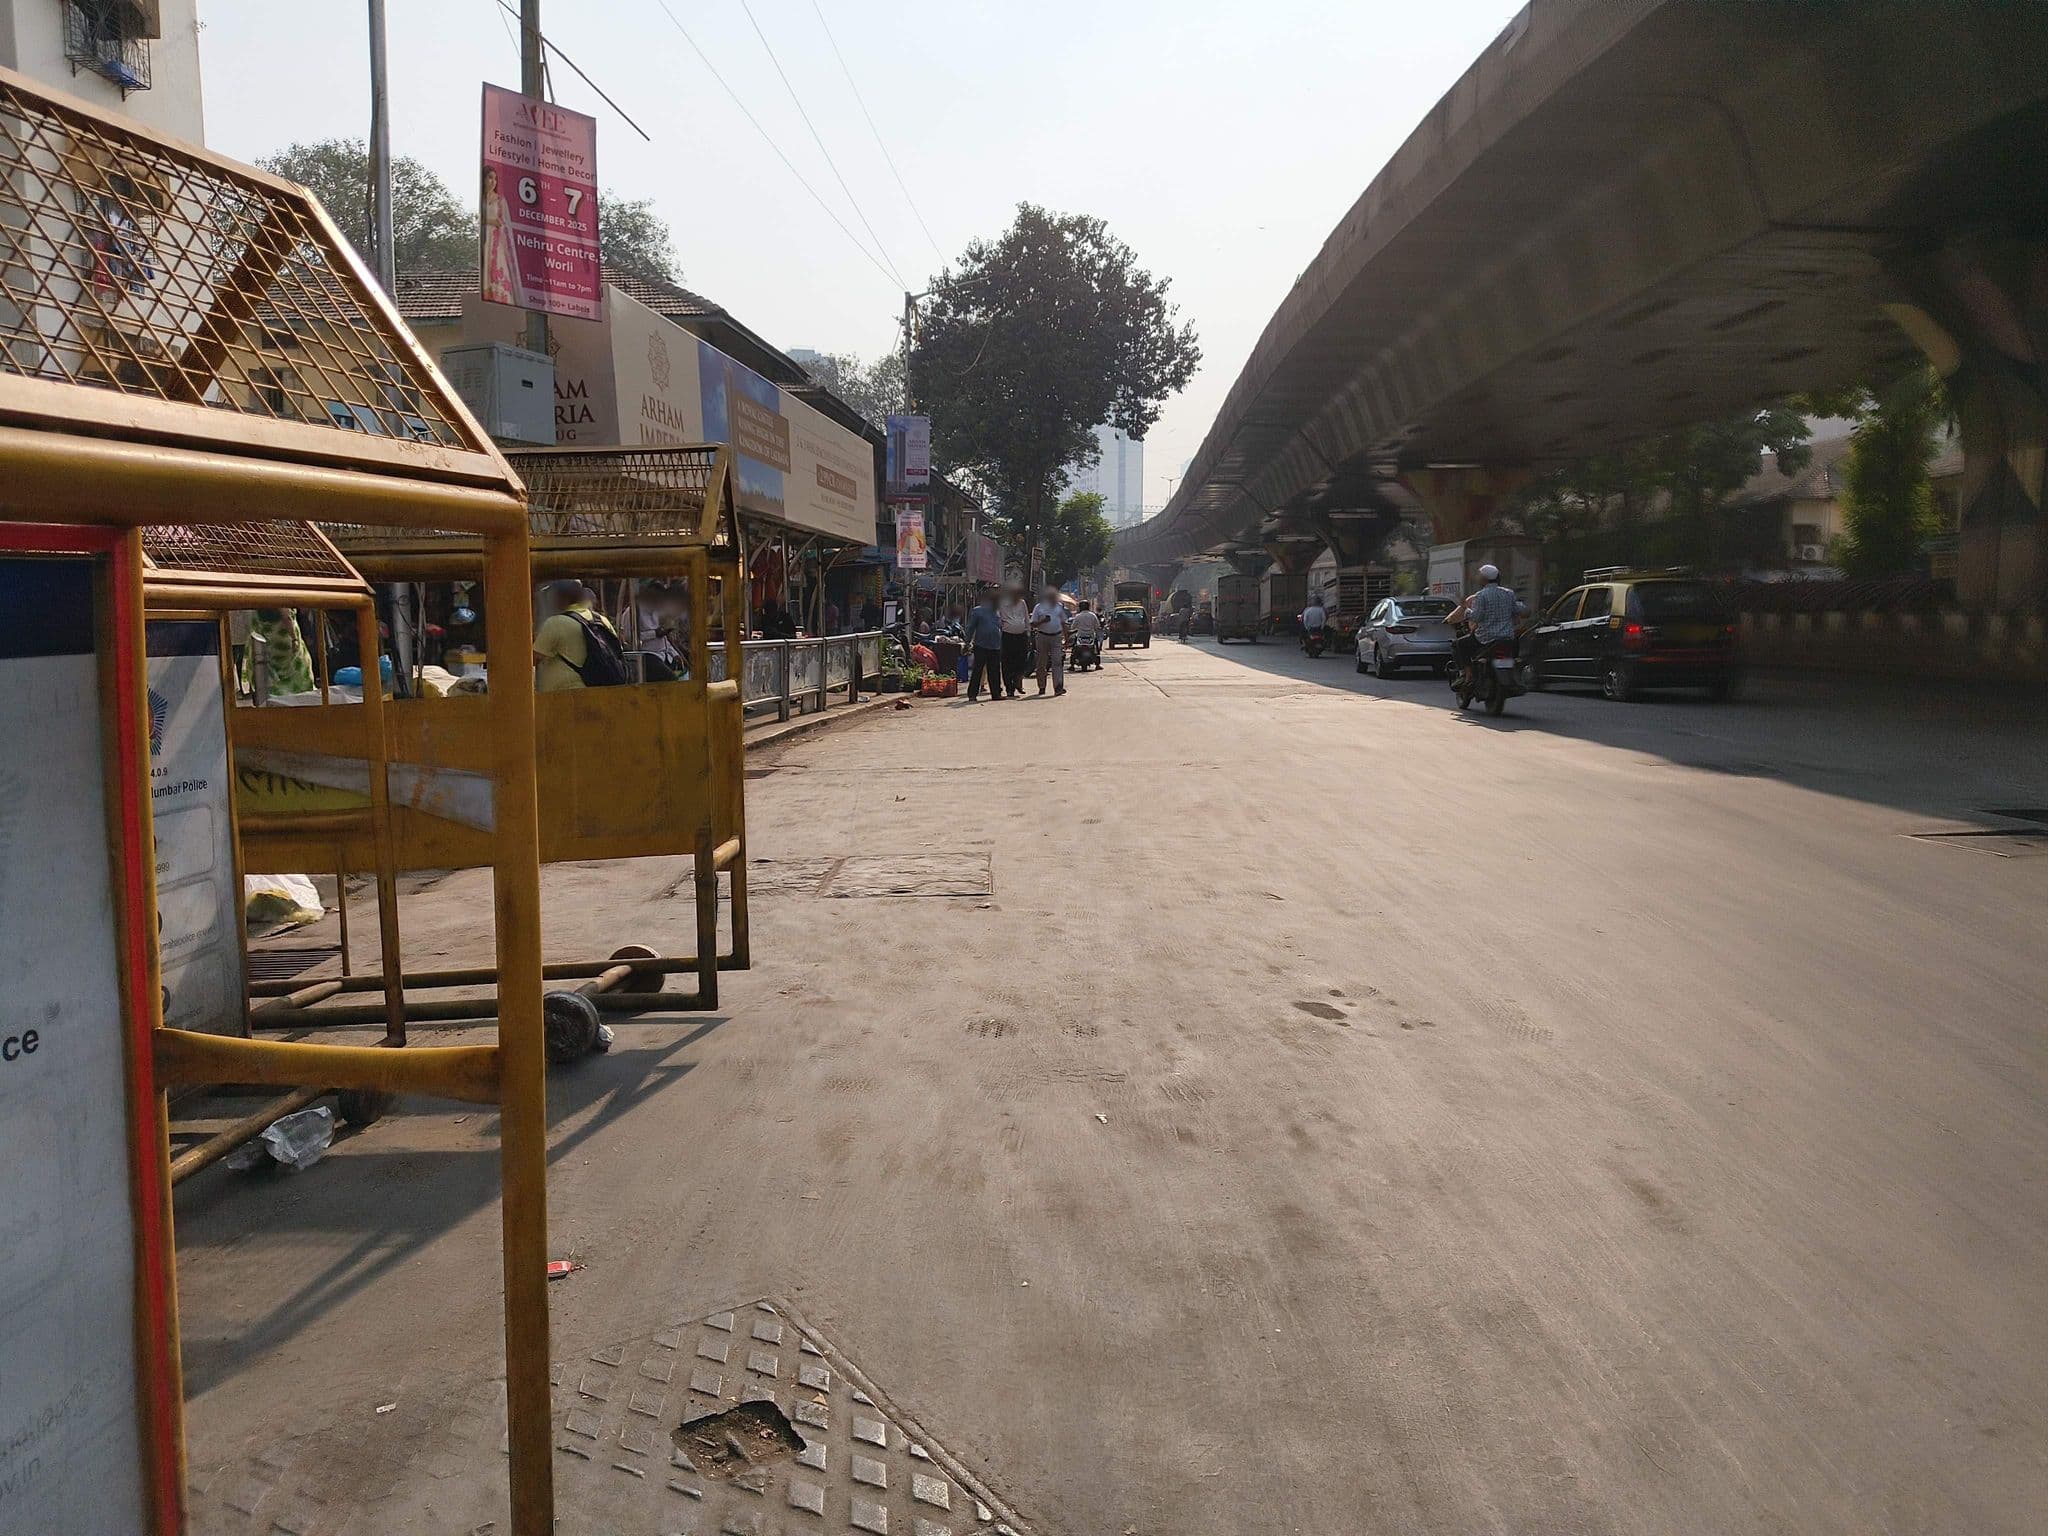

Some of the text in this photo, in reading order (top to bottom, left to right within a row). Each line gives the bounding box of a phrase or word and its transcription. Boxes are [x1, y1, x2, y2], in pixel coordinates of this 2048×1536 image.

[494, 130, 532, 148] Fashion
[541, 143, 585, 166] Jewellery
[489, 144, 530, 164] Lifestyle
[538, 158, 566, 174] Home
[568, 166, 595, 180] Decor
[519, 208, 588, 232] DECEMBER 2025
[517, 234, 599, 263] Nehru Centre,
[544, 257, 574, 273] Worli
[568, 282, 576, 290] to
[577, 285, 592, 293] 7pm
[567, 303, 590, 313] Labels
[554, 379, 590, 400] AM
[555, 403, 595, 425] RIA
[641, 393, 685, 433] ARHAM
[182, 779, 208, 793] Police
[2, 1028, 39, 1062] ce
